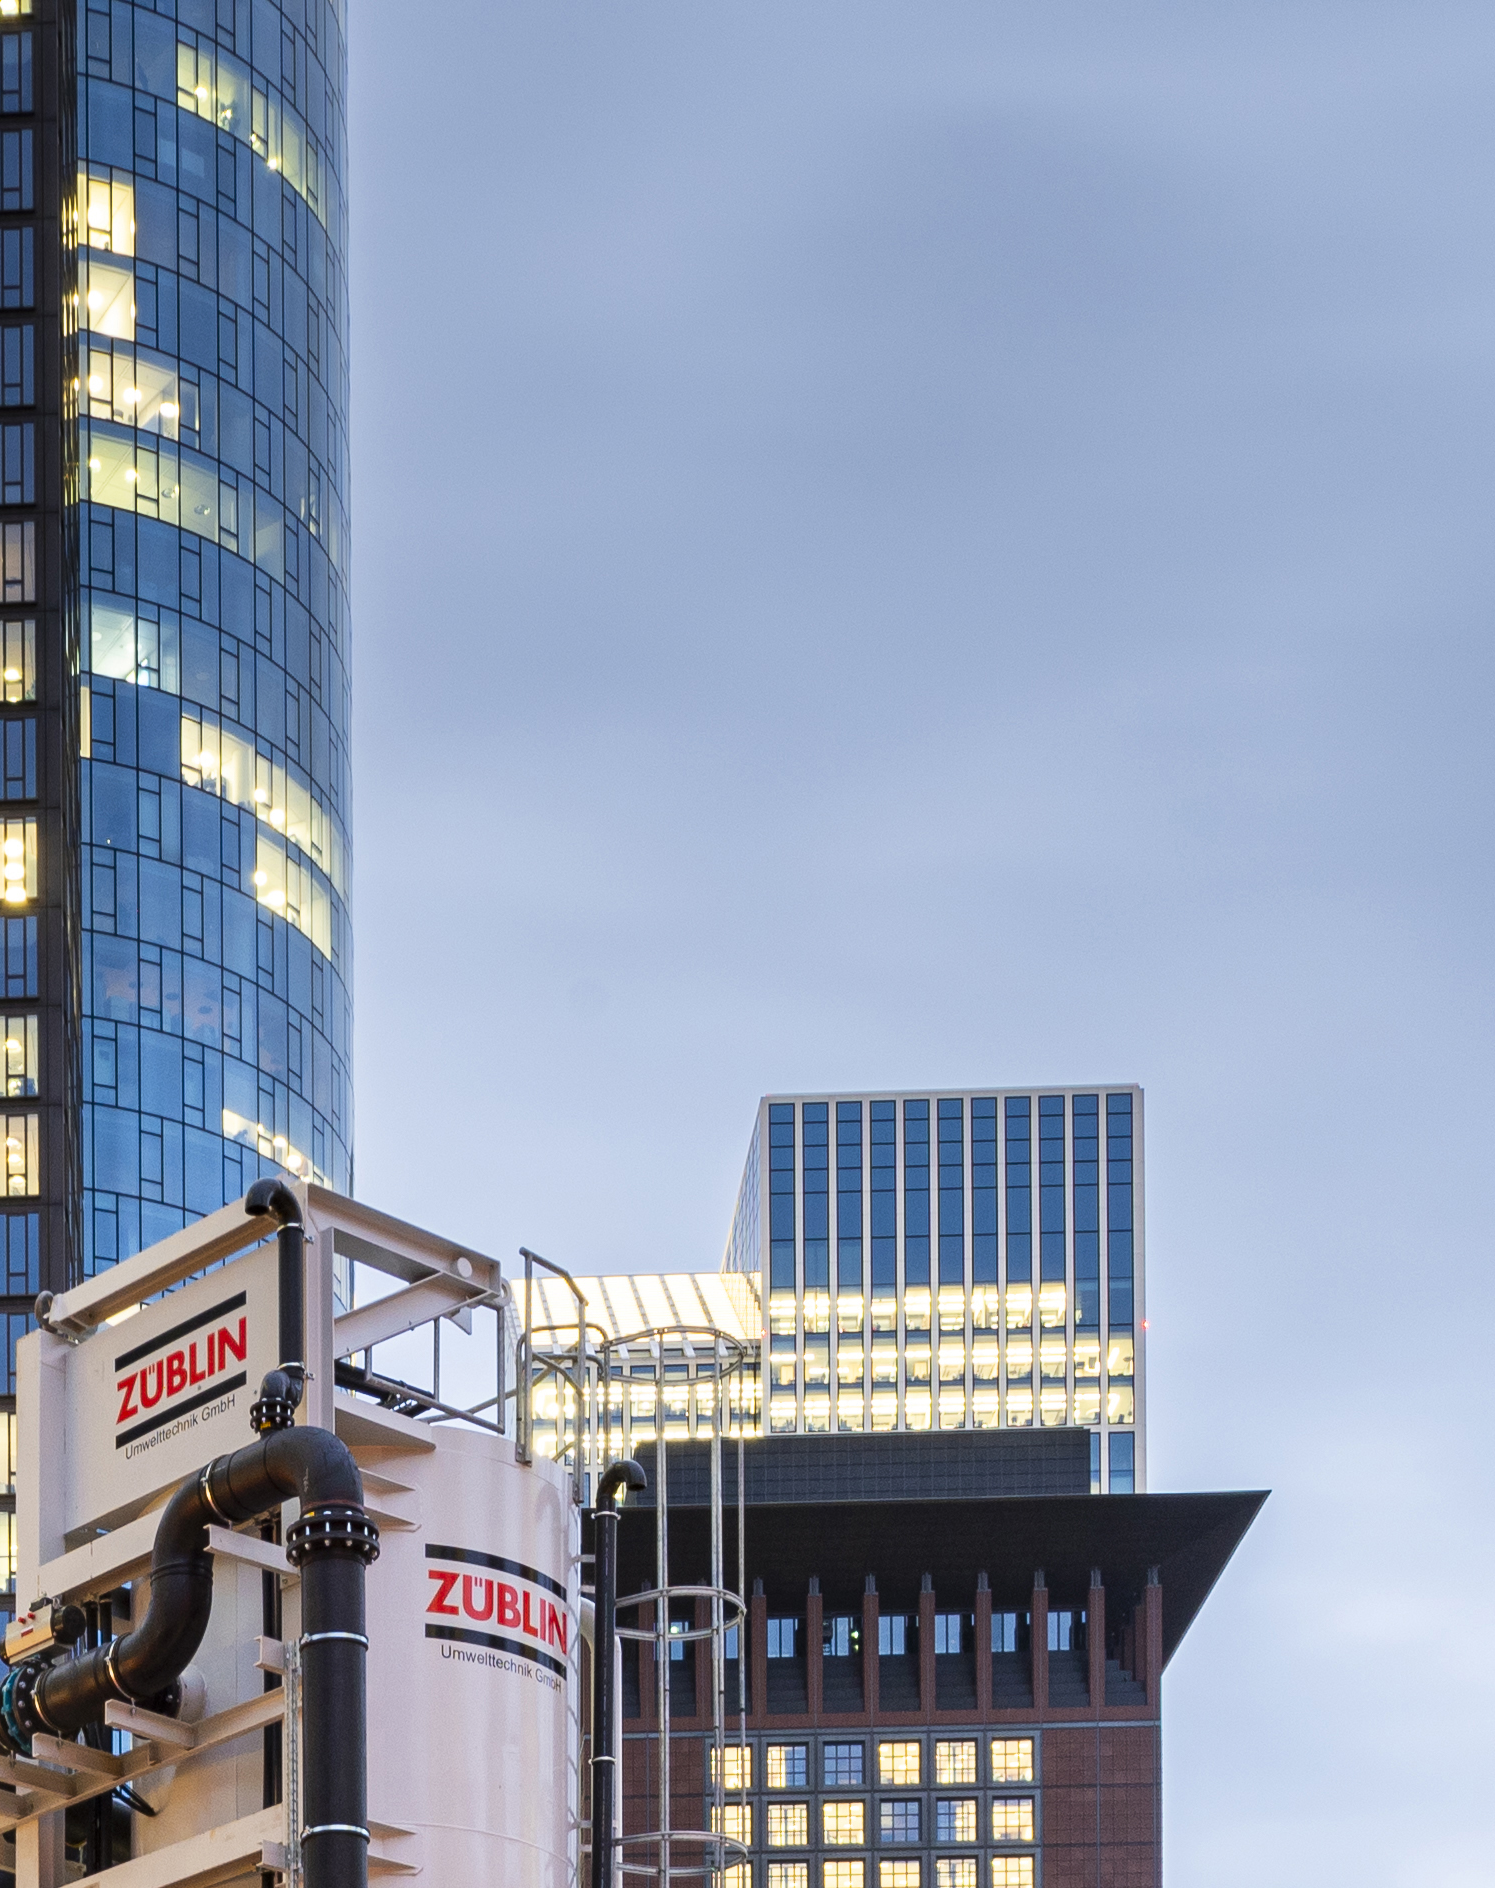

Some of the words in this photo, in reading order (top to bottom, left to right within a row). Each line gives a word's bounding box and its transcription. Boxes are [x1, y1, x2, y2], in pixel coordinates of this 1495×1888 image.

[116, 1316, 247, 1425] ZÜBLIN
[125, 1413, 199, 1459] Umwelttechnik
[201, 1394, 236, 1421] GmbH
[426, 1569, 567, 1656] ZÜBLIN
[441, 1644, 533, 1678] Umwelttechnik
[535, 1669, 562, 1693] GmbH
